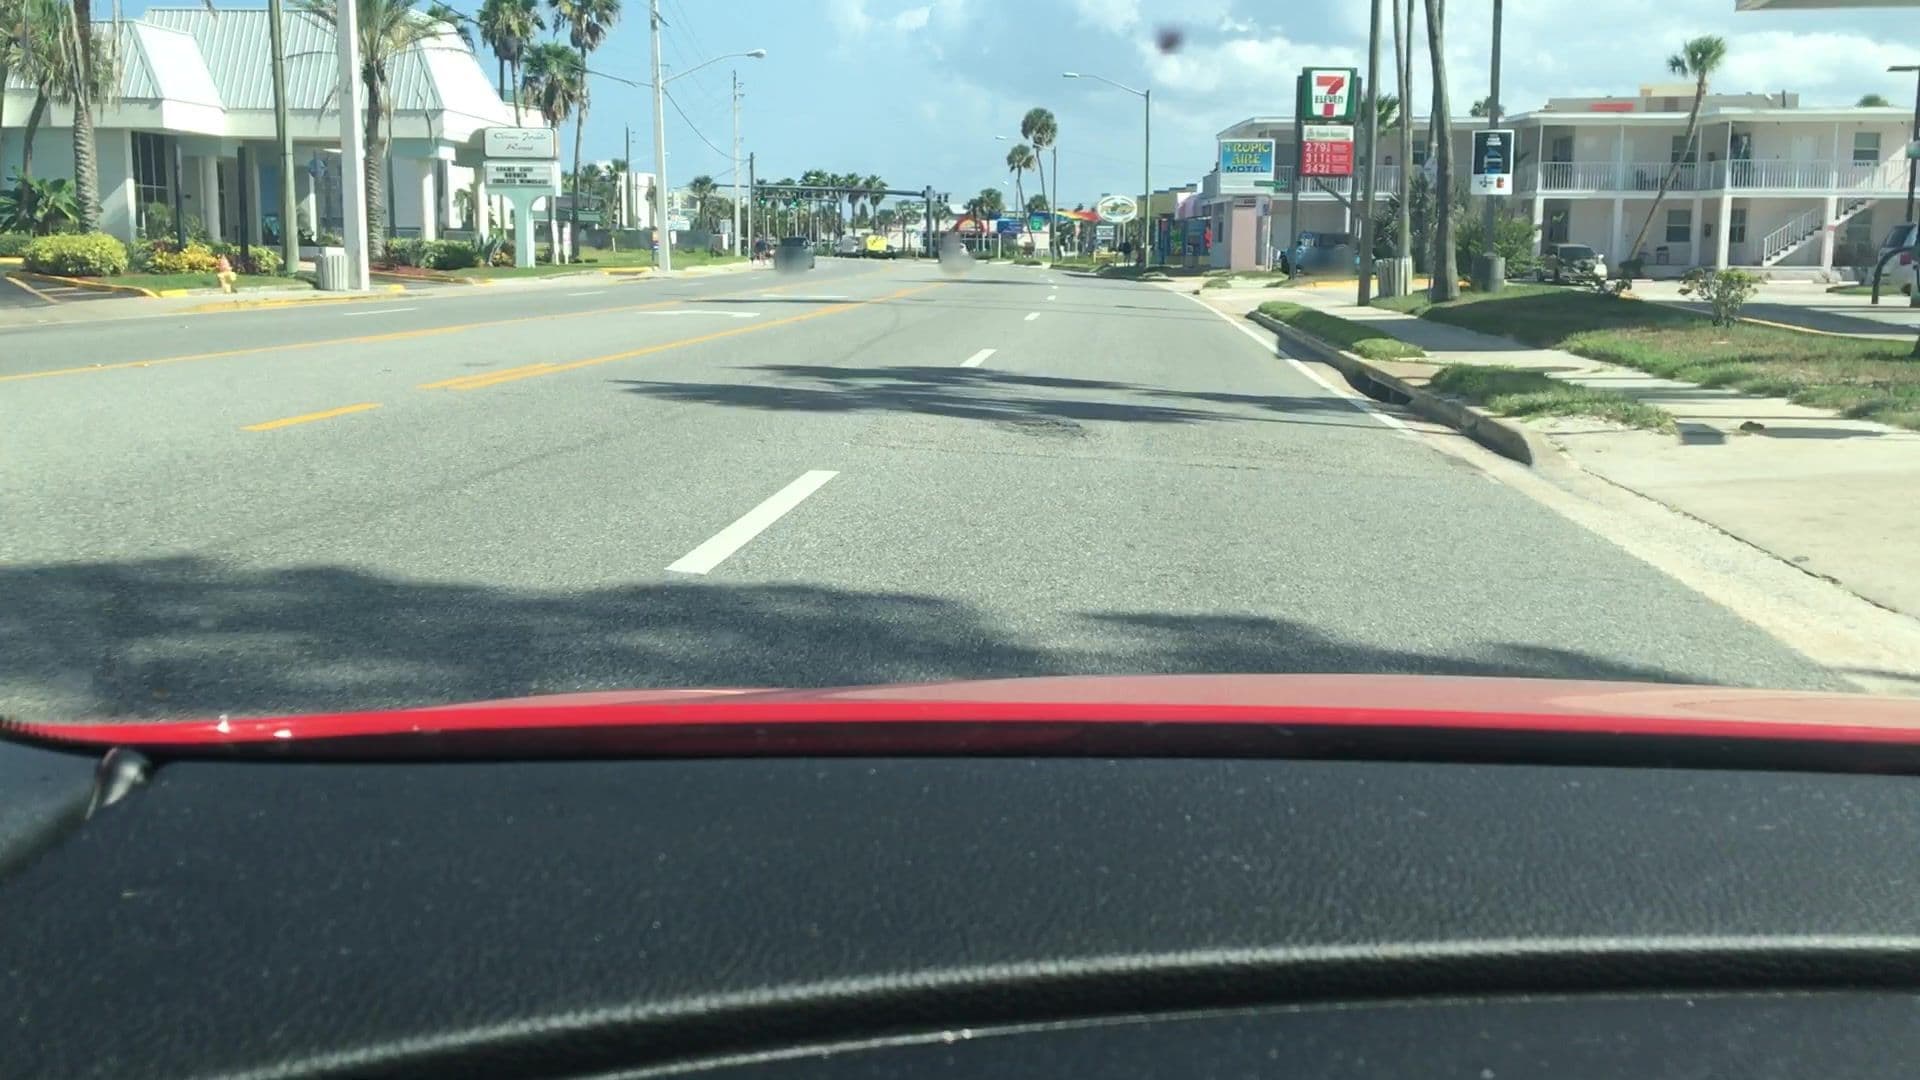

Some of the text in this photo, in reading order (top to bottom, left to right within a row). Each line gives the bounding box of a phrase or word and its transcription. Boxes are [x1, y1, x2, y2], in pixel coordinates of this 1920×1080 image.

[1316, 76, 1345, 116] 7
[1223, 142, 1270, 153] TROPIC
[1231, 153, 1263, 164] AIRE
[1226, 165, 1267, 173] MOTEL
